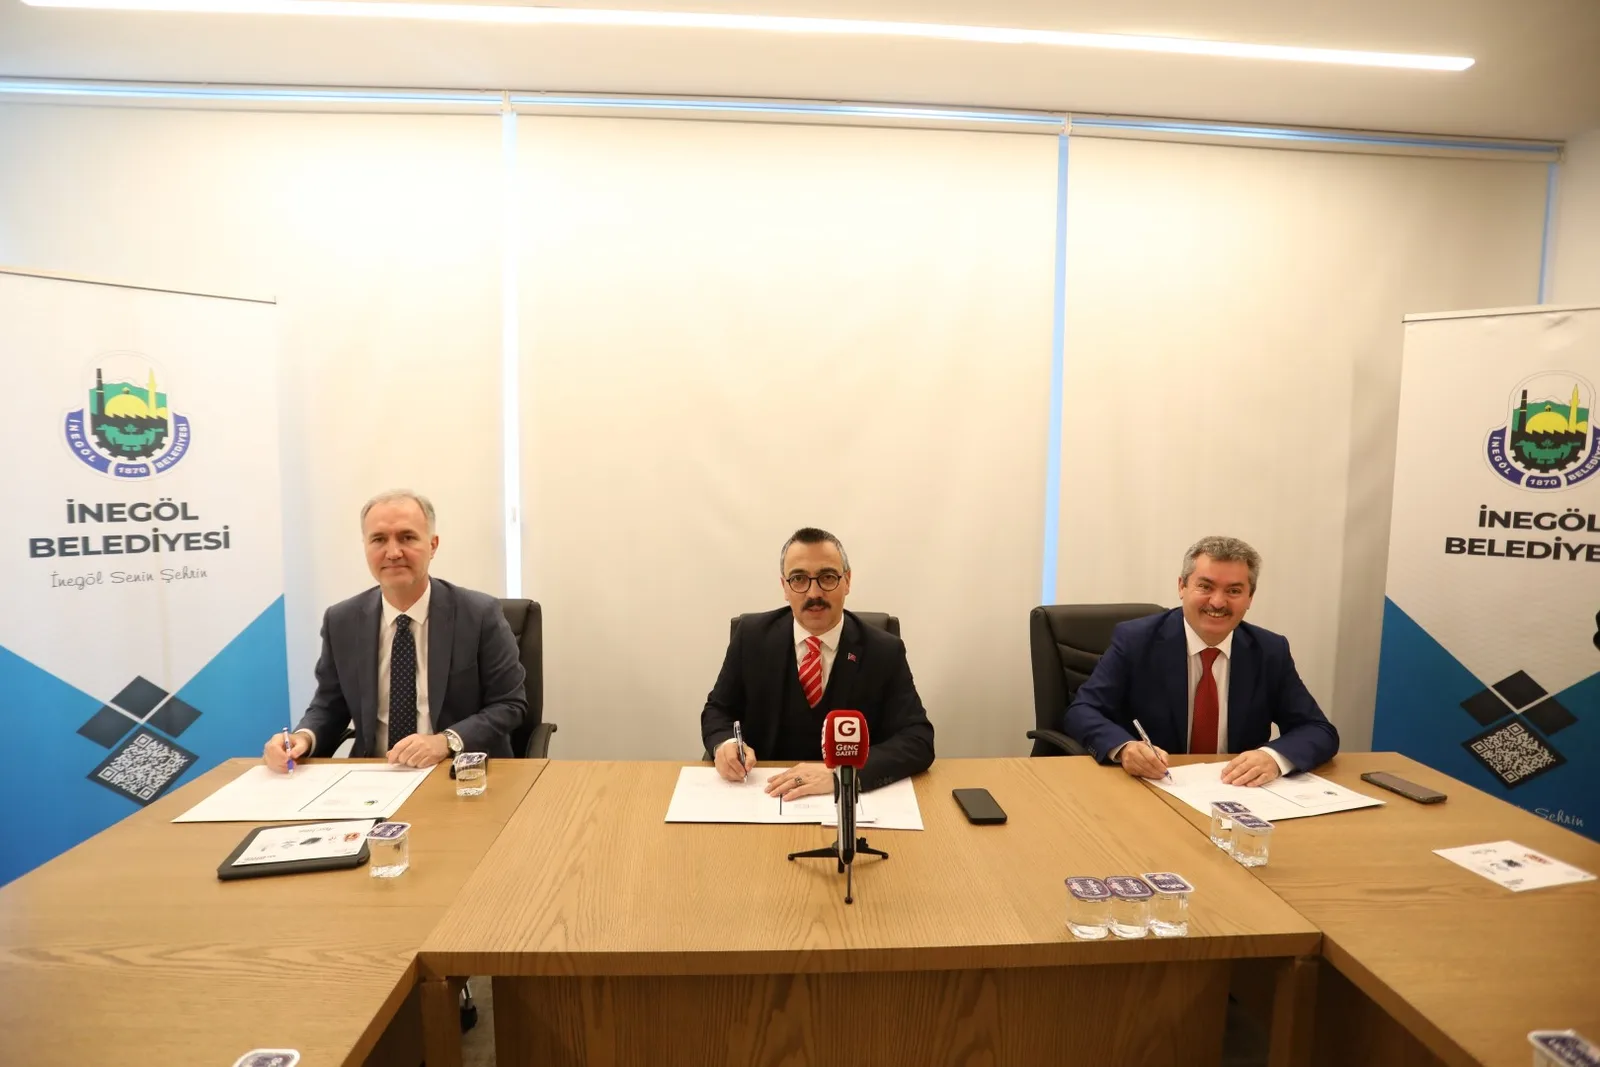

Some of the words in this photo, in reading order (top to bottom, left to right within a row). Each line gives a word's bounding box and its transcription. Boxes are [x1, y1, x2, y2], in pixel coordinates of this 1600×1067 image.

[118, 466, 147, 474] 1870
[66, 498, 199, 524] İNEGÖL
[1478, 504, 1600, 533] İNEGÖL
[28, 525, 230, 559] BELEDİYESİ
[50, 571, 104, 590] İnegöl
[110, 571, 154, 584] Senin
[160, 566, 208, 583] Şehrin
[838, 720, 856, 736] G
